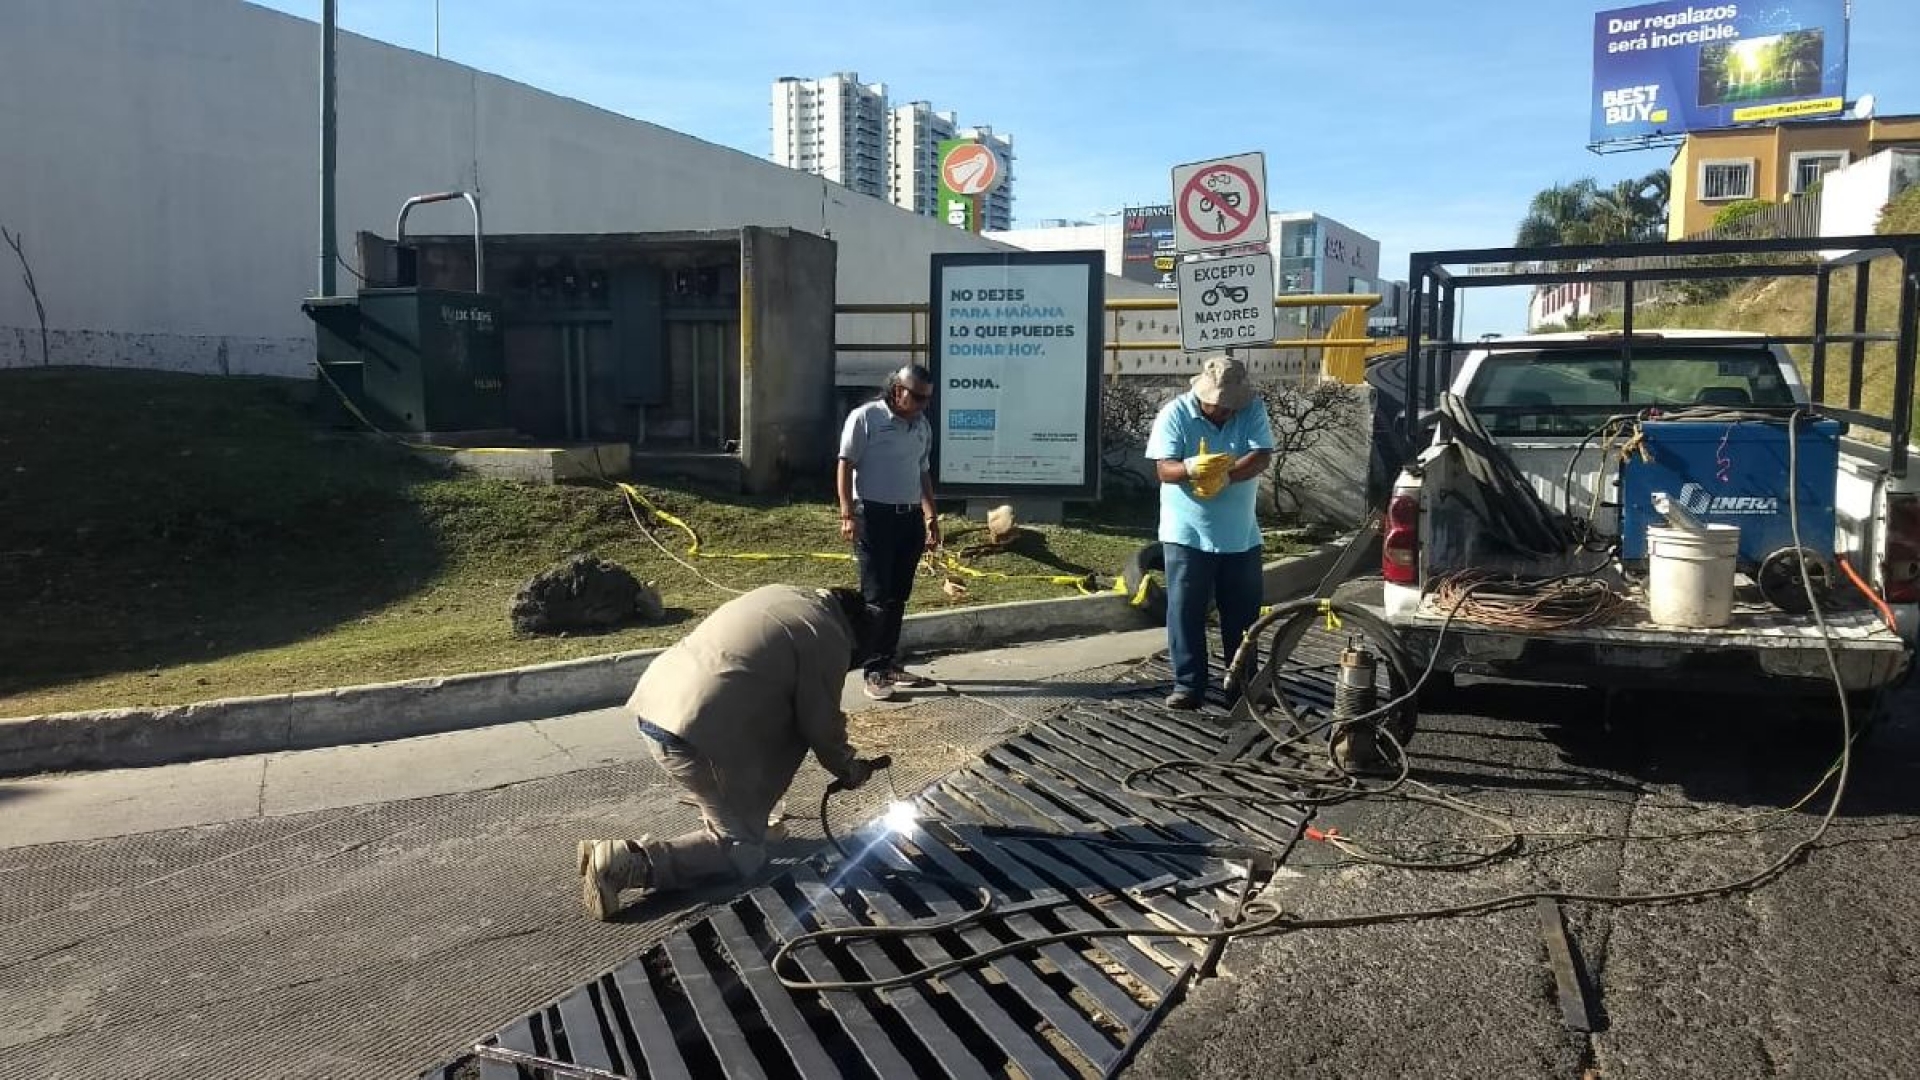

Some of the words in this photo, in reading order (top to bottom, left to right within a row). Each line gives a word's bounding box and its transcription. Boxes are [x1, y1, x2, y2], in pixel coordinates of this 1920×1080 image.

[1608, 19, 1641, 34] Dar
[1644, 4, 1737, 29] regalazos
[1607, 33, 1647, 53] será
[1603, 85, 1659, 108] BEST
[1605, 103, 1655, 125] BUY
[1194, 264, 1255, 282] EXCEPTO
[951, 289, 973, 301] NO
[977, 288, 1025, 301] DEJES
[949, 308, 990, 318] PARA
[996, 303, 1065, 318] MAÑANA
[1195, 307, 1259, 323] MAYORES
[949, 326, 969, 337] LO
[975, 325, 1007, 338] QUE
[1010, 325, 1075, 337] PUEDES
[1200, 329, 1208, 340] A
[1212, 327, 1233, 339] 250
[1238, 325, 1255, 337] CC
[949, 344, 1005, 356] DONAR
[1009, 343, 1046, 356] HOY.
[949, 379, 1000, 389] DONA.
[1711, 497, 1777, 509] INFRA
